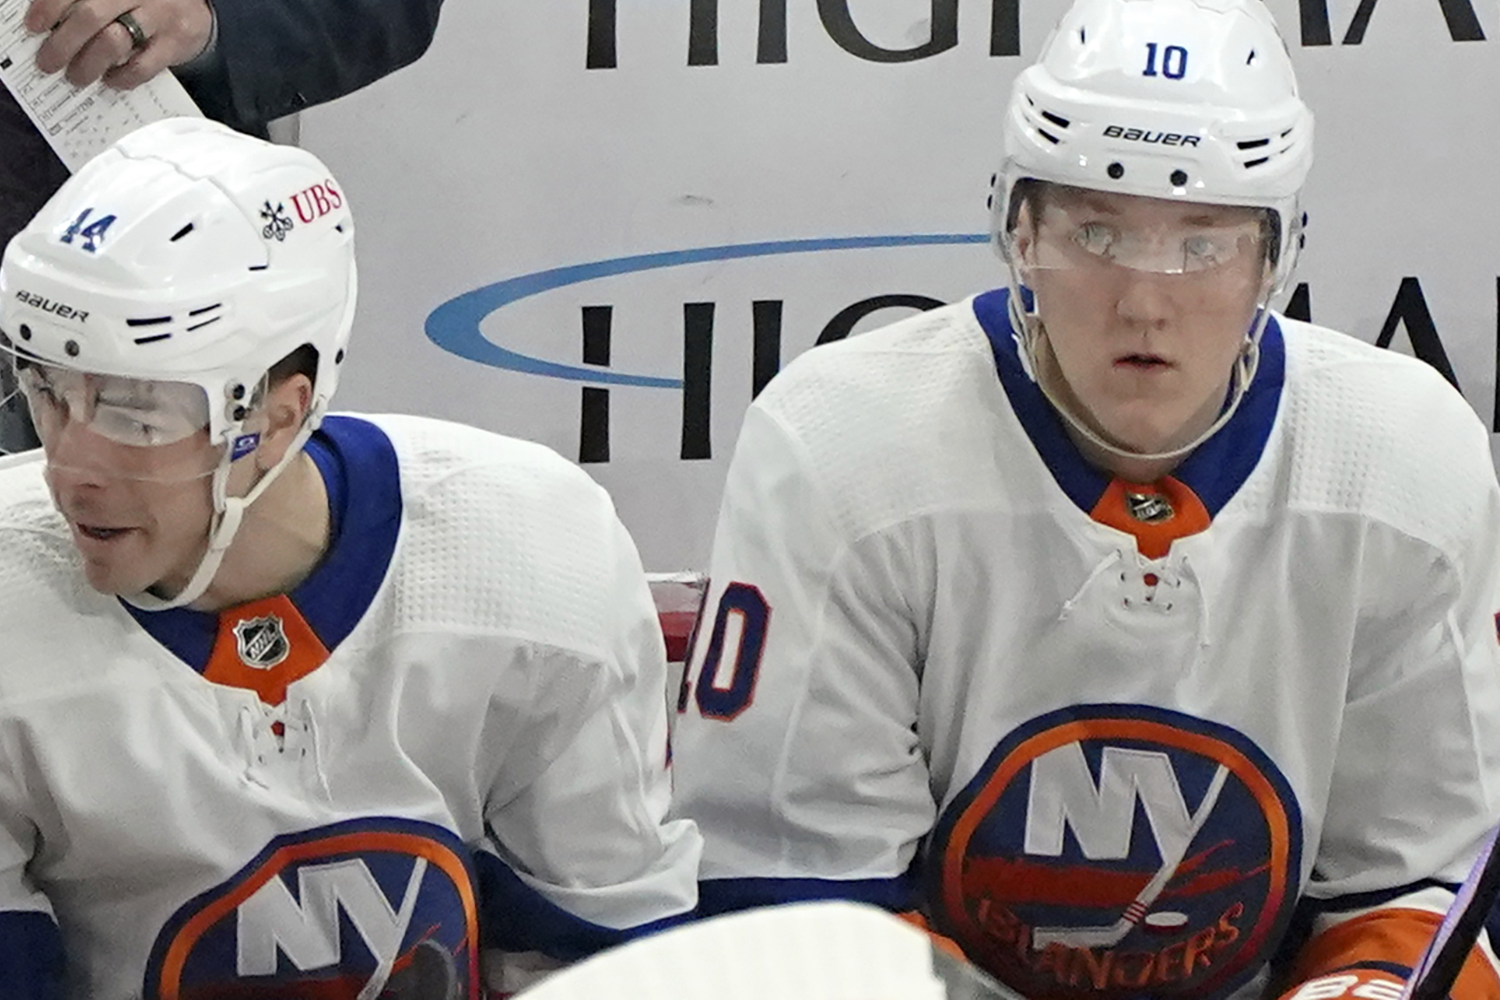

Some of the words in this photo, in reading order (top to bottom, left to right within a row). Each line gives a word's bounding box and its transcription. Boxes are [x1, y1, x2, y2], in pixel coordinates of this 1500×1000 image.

[1142, 42, 1189, 81] 10
[1102, 124, 1202, 148] BAUER
[289, 178, 343, 224] UBS
[59, 206, 118, 253] 14
[14, 288, 90, 323] BAUER
[677, 577, 774, 722] 0
[1023, 740, 1230, 862] NY
[236, 855, 428, 977] NY
